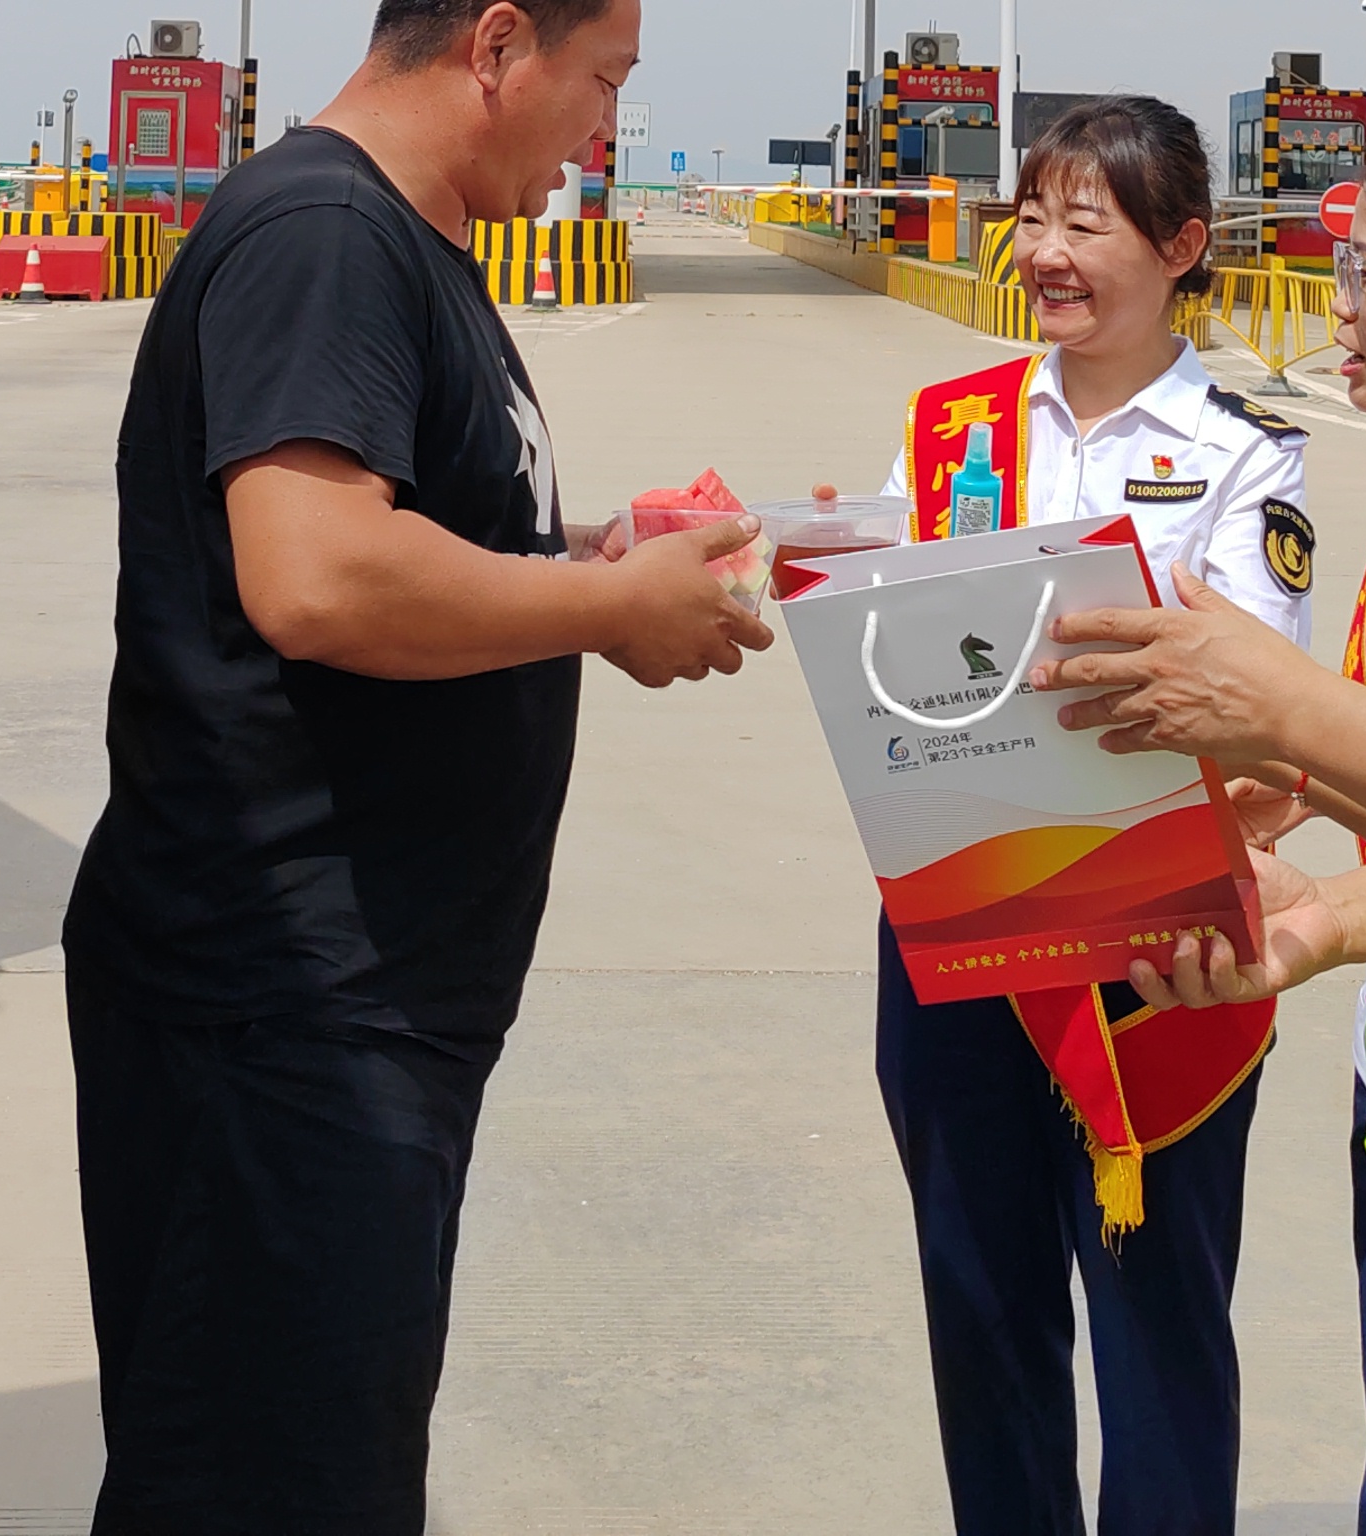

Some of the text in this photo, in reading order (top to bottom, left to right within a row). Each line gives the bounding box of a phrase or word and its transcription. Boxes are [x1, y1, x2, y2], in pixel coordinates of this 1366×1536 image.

[922, 731, 973, 750] 2024年
[927, 737, 1036, 765] 第23个安全生产月
